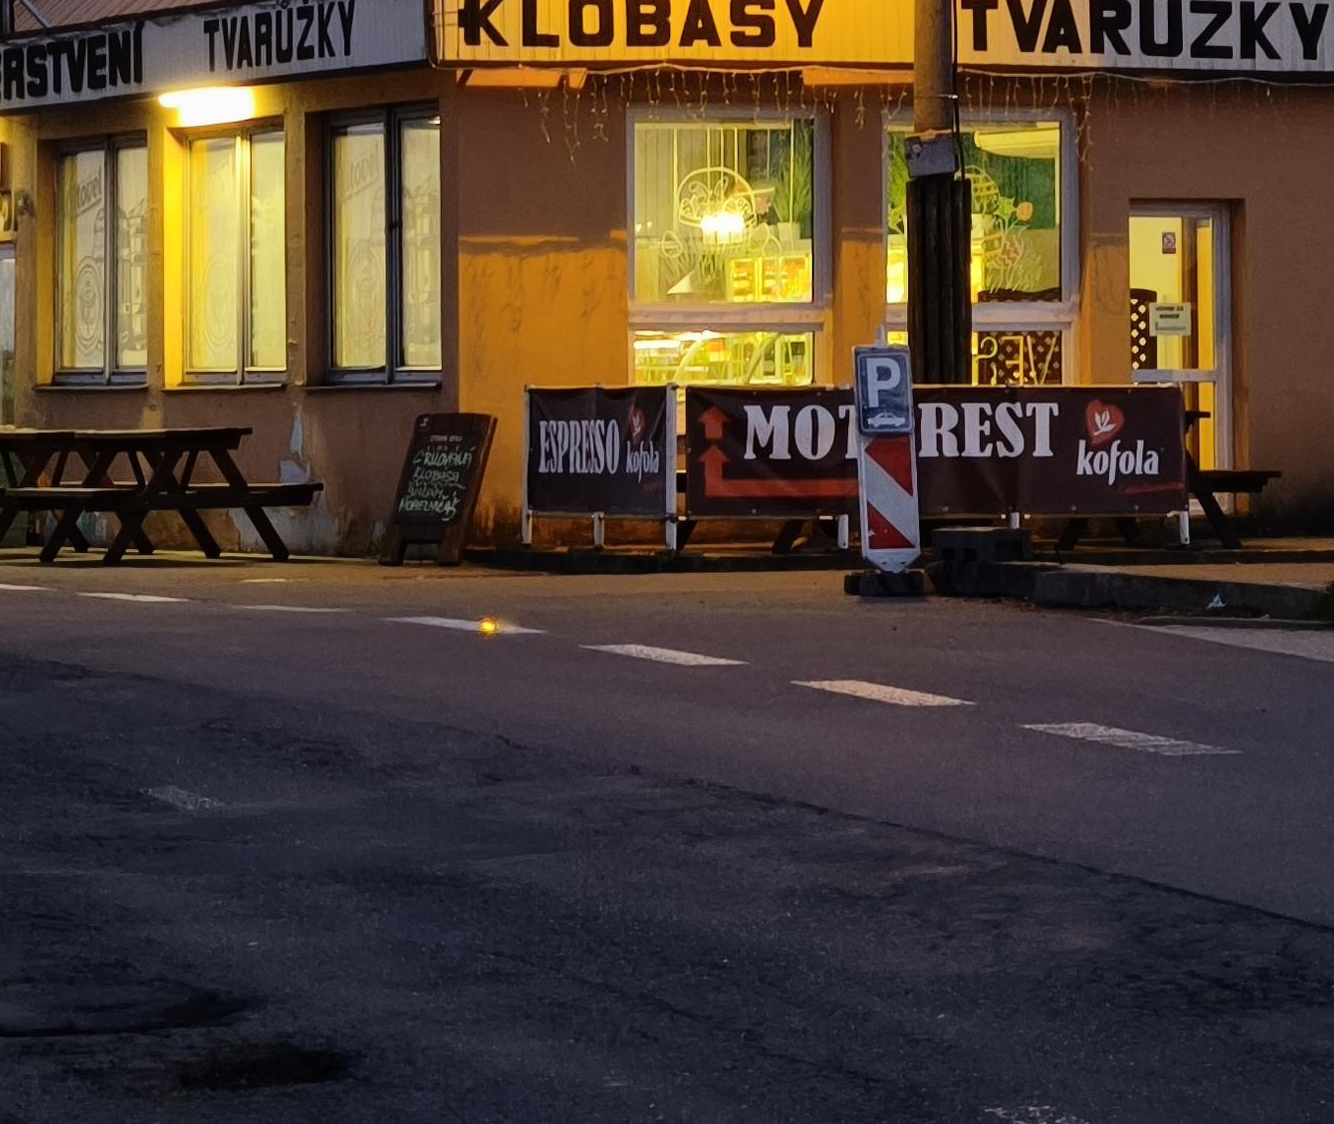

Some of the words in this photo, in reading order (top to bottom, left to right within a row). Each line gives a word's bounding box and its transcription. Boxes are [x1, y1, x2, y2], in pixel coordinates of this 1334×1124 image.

[867, 358, 901, 408] P
[539, 419, 620, 474] ESPRESSO
[743, 401, 1059, 461] MOTREST
[626, 440, 660, 484] kofola
[1076, 439, 1160, 486] kofola
